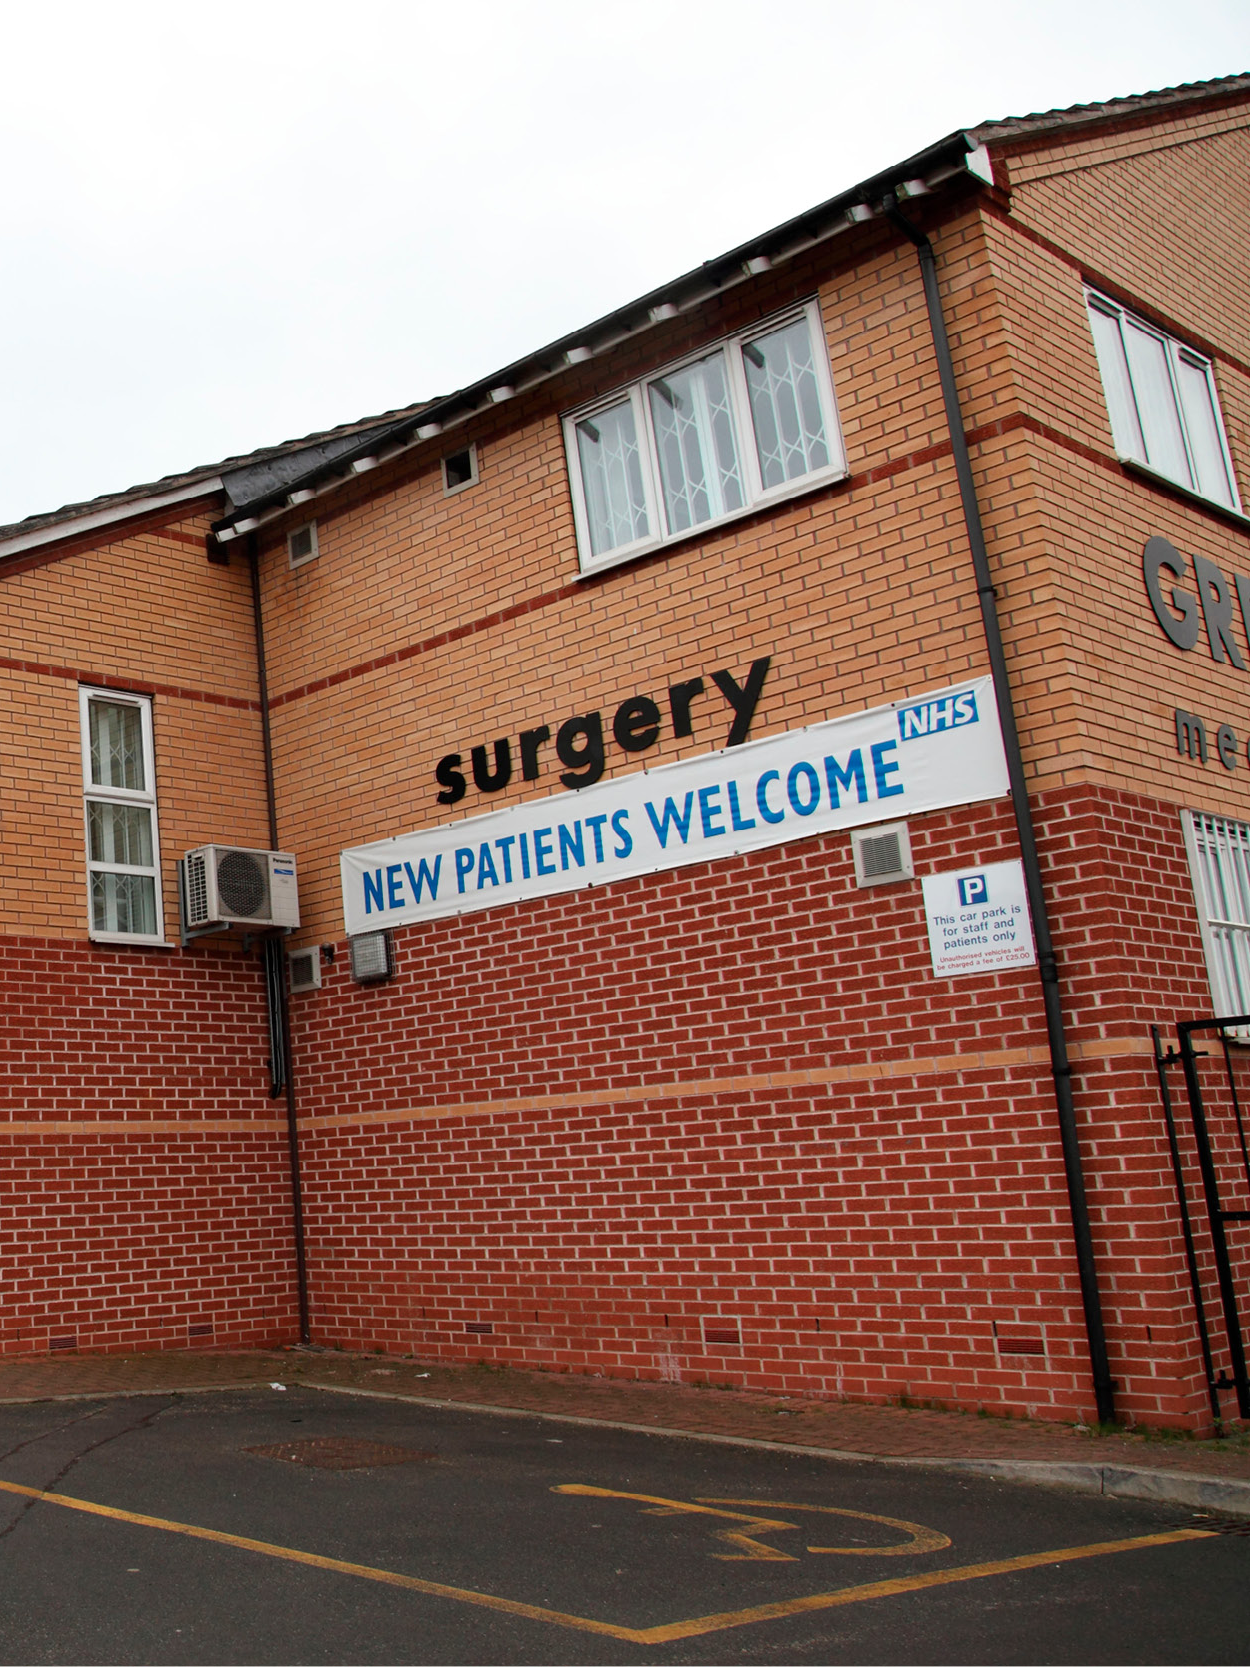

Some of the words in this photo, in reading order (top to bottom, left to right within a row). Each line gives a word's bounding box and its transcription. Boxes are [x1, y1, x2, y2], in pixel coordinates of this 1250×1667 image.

[904, 693, 974, 739] NHS
[436, 656, 771, 805] surgery
[1175, 708, 1250, 770] me
[362, 855, 442, 915] NEW
[456, 808, 633, 894] PATIENTS
[644, 740, 904, 849] WELCOME
[963, 877, 984, 904] P
[933, 915, 955, 926] This
[960, 913, 977, 921] car
[982, 907, 1006, 920] park
[1011, 905, 1021, 914] is
[943, 927, 958, 937] for
[963, 922, 989, 933] staff
[994, 917, 1014, 929] and
[944, 936, 988, 950] patients
[993, 931, 1016, 941] only
[940, 953, 982, 962] Unauthorised
[948, 961, 974, 970] charged
[1005, 952, 1030, 961] £25.00
